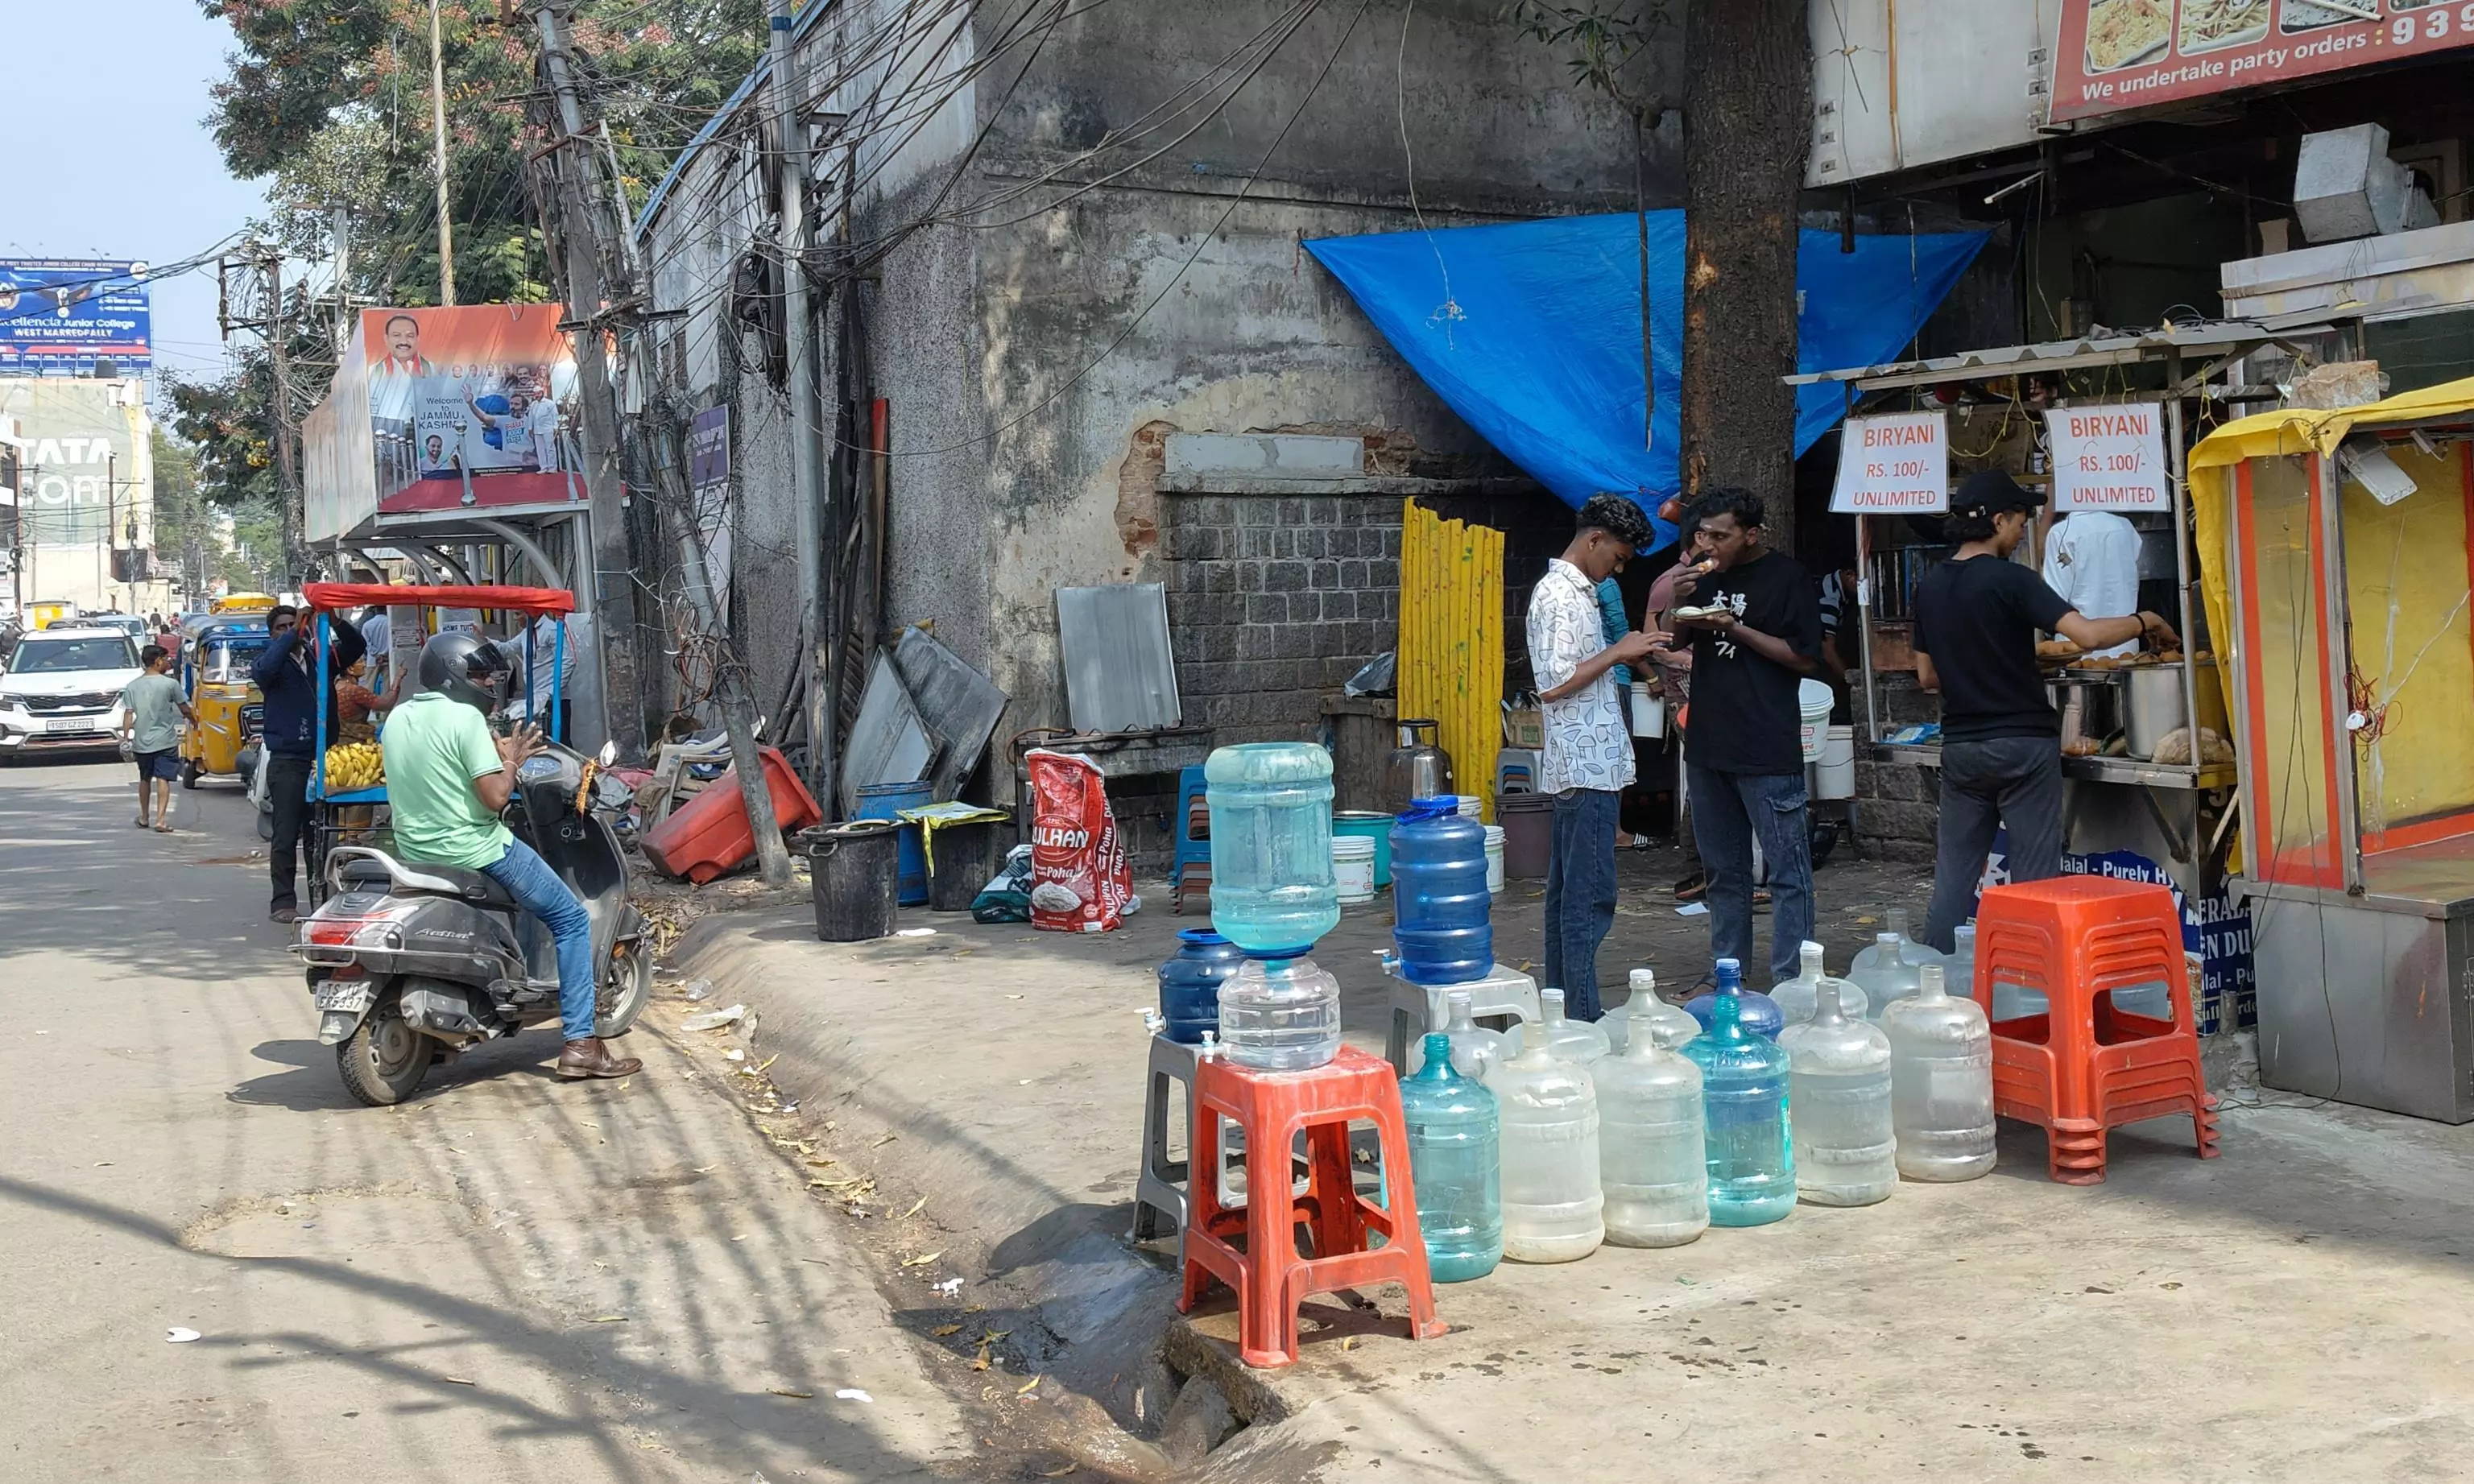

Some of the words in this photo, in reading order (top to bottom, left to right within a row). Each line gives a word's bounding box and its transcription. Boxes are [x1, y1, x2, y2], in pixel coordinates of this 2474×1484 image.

[2082, 82, 2112, 101] We
[2120, 62, 2224, 94] undertake
[2230, 48, 2288, 76] party
[2294, 34, 2367, 60] orders
[14, 329, 42, 337] WEST
[63, 317, 94, 327] Junior
[96, 318, 135, 329] College
[426, 397, 464, 405] Welcome
[420, 411, 459, 420] JAMMU
[1864, 424, 1934, 449] BIRYANI
[2071, 415, 2149, 439] BIRYANI
[21, 437, 112, 465] TATA
[1866, 462, 1888, 478] RS.
[1893, 459, 1930, 479] 100/-
[2079, 456, 2103, 473] RS.
[2107, 453, 2146, 473] 100/-
[1853, 490, 1936, 506] UNLIMITED
[2073, 486, 2156, 504] UNLIMITED
[1099, 826, 1112, 854] Poha
[1047, 866, 1074, 878] Poha
[2103, 861, 2149, 883] Purely
[1101, 879, 1115, 919] DULHAN
[327, 983, 341, 996] TS
[347, 984, 360, 996] 10
